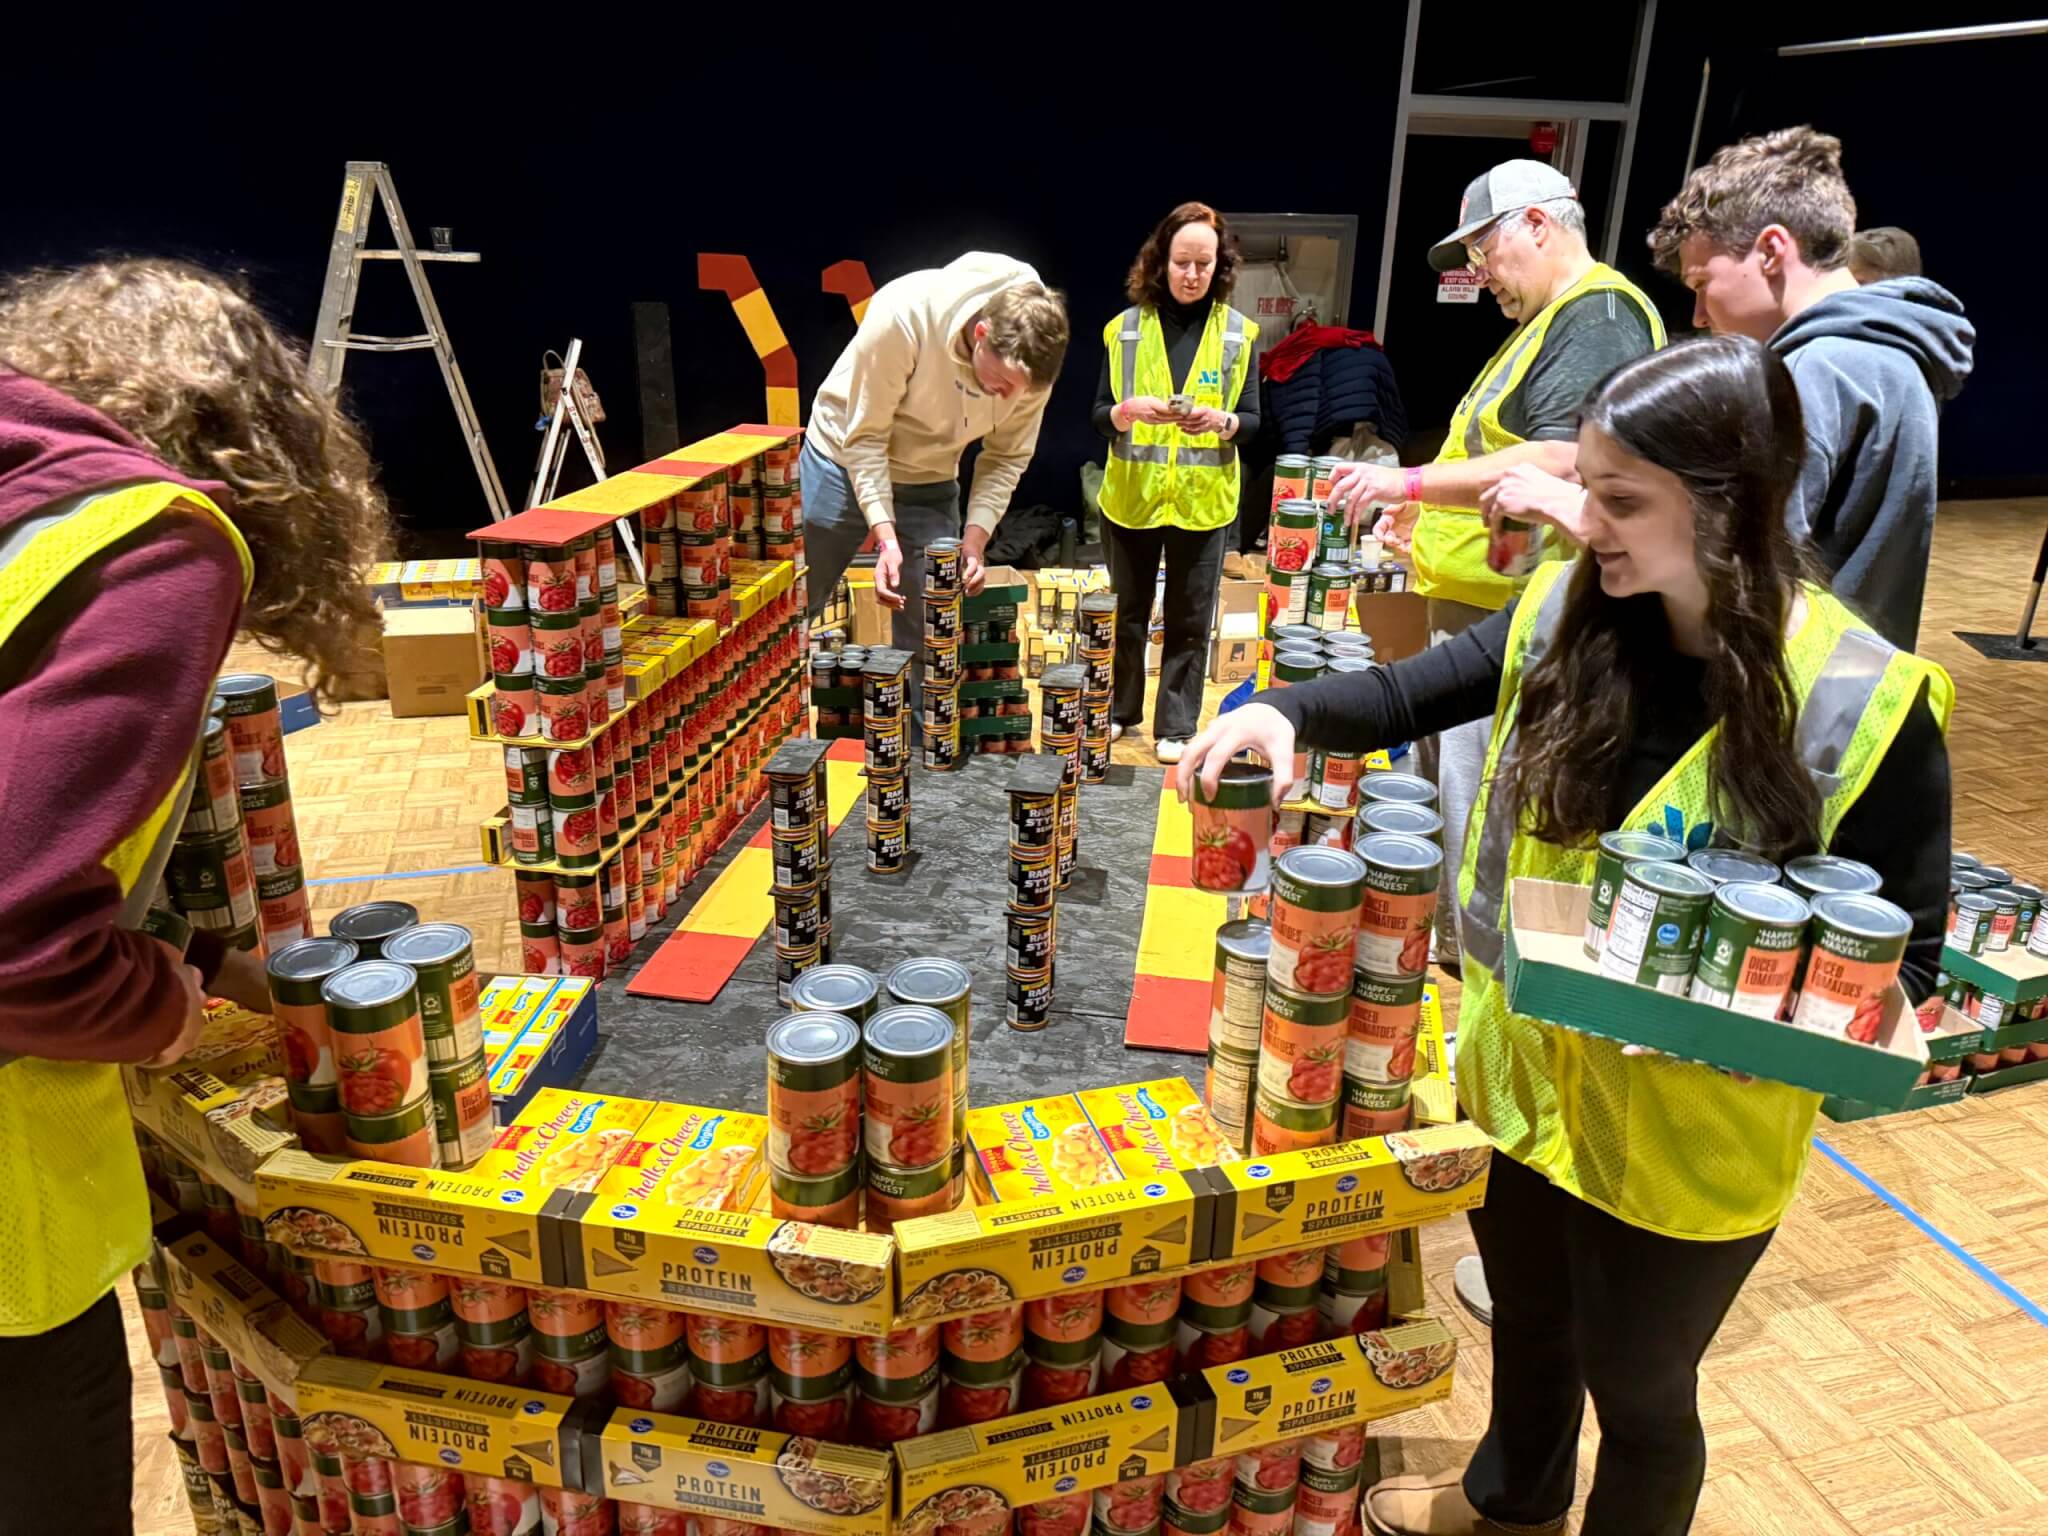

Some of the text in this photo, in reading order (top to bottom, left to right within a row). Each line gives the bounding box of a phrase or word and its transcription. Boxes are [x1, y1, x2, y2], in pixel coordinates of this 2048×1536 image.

[1030, 804, 1053, 817] RAN
[1028, 868, 1052, 879] RAN
[1756, 936, 1797, 949] HARVEST
[1759, 929, 1793, 942] HAPPY
[1824, 929, 1862, 947] HAPPY
[1821, 937, 1869, 959] HARVEST
[1748, 956, 1779, 972] DICED
[1814, 956, 1845, 978] DICED
[1356, 987, 1397, 1002] HARVEST
[1357, 980, 1390, 994] HAPPY
[1811, 971, 1863, 998] TOMATOES
[231, 1050, 281, 1078] Shell
[1351, 1096, 1391, 1108] HARVEST
[1352, 1088, 1384, 1101] HAPPY
[538, 1098, 582, 1140] Cheese
[572, 1104, 598, 1131] Original
[1116, 1092, 1152, 1132] Cheese
[659, 1113, 702, 1156] Cheese
[695, 1119, 717, 1148] Original
[1140, 1132, 1157, 1141] &
[533, 1140, 551, 1150] &
[1000, 1111, 1056, 1198] hells & Cheese
[1303, 1143, 1363, 1160] PROTEIN
[499, 1149, 542, 1182] hells
[656, 1157, 674, 1167] &
[1141, 1141, 1177, 1175] hells
[426, 1178, 495, 1198] PROTEIN
[624, 1165, 667, 1200] hells
[1071, 1189, 1136, 1210] PROTEIN
[1306, 1190, 1383, 1219] PROTEIN
[682, 1208, 752, 1228] PROTEIN
[994, 1207, 1061, 1226] SPAGHETTI
[1307, 1209, 1377, 1230] SPAGHETTI
[379, 1218, 462, 1246] PROTEIN
[678, 1220, 746, 1237] SPAGHETTI
[1036, 1224, 1116, 1250] SPAGHETTI
[1032, 1238, 1118, 1271] PROTEIN
[663, 1263, 752, 1292] PROTEIN
[1279, 1343, 1337, 1363] PROTEIN
[453, 1388, 517, 1410] PROTEIN
[1283, 1389, 1355, 1419] PROTEIN
[1061, 1402, 1123, 1425] PROTEIN
[1283, 1407, 1352, 1431] SPAGHETTI
[410, 1425, 489, 1453] PROTEIN
[696, 1422, 761, 1442] PROTEIN
[1029, 1437, 1106, 1465] SPAGHETTI
[1026, 1451, 1106, 1483] PROTEIN
[677, 1474, 762, 1502] PROTEIN
